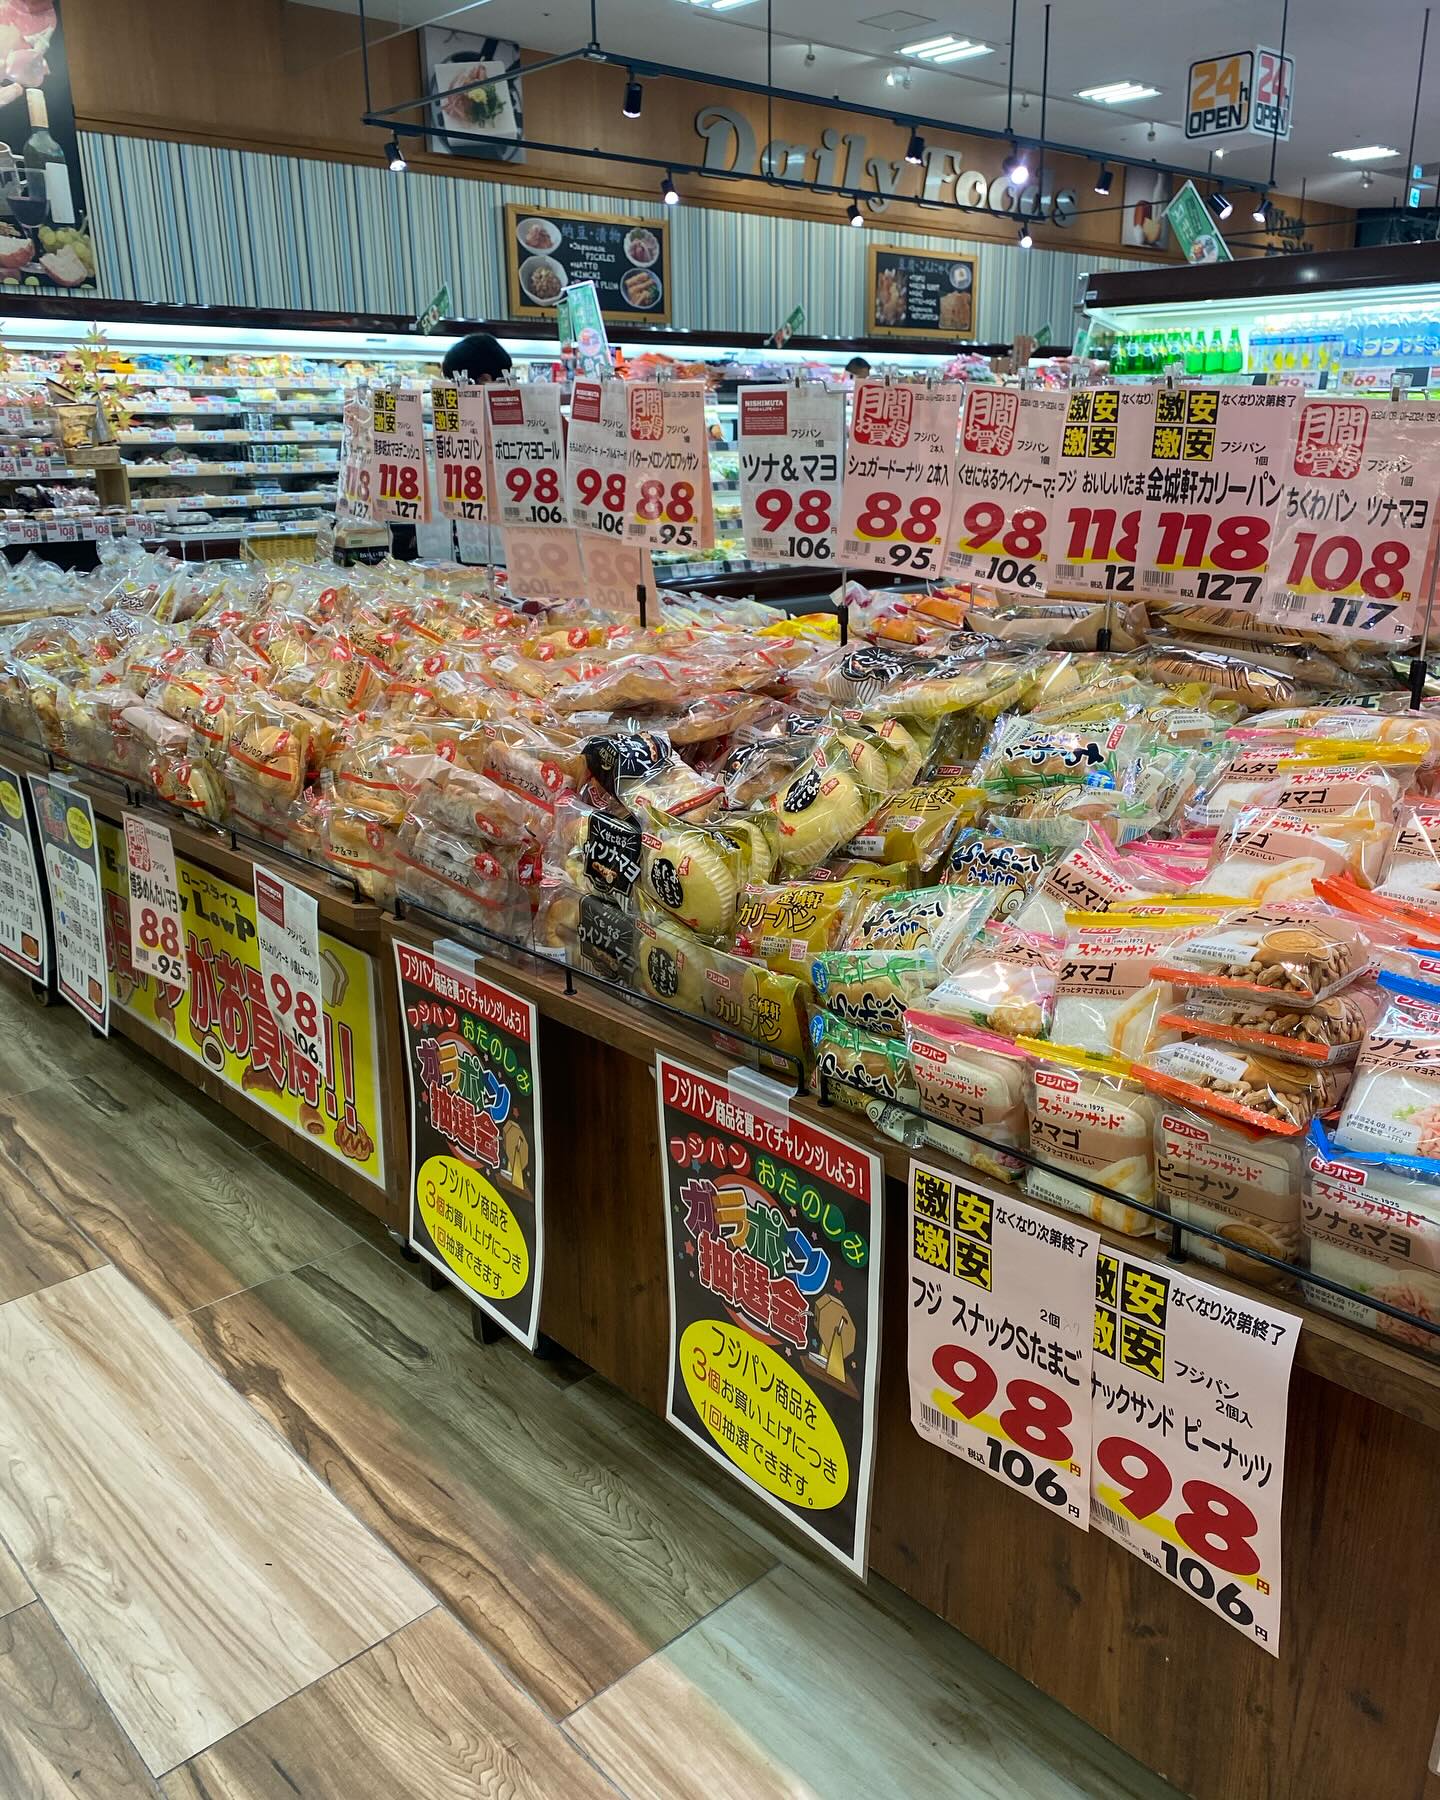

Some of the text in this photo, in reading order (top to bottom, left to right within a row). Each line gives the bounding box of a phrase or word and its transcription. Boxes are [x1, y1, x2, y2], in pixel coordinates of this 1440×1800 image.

[1190, 104, 1242, 134] OPEN
[1255, 102, 1287, 131] OPEN
[695, 106, 1079, 228] Daily Foods
[1121, 393, 1153, 405] なくなり
[1221, 393, 1297, 408] なくなり次第終了
[791, 429, 821, 438] フジパン
[914, 432, 940, 443] フジパン
[1017, 439, 1049, 453] フジパン
[1152, 426, 1216, 462] 激安
[1220, 441, 1266, 453] フジパン
[742, 453, 837, 482] ツナ&マヨ
[848, 456, 949, 487] シュガードーナツ 2本入
[1254, 456, 1268, 466] 1個
[1367, 459, 1413, 473] フジパン
[379, 463, 419, 500] 118
[444, 464, 483, 500] 118
[506, 467, 559, 503] 98
[576, 468, 626, 513] 98
[1058, 469, 1076, 492] フジ
[1146, 466, 1284, 508] 金城軒カリーパン
[395, 501, 418, 519] 127
[461, 502, 483, 520] 127
[531, 506, 562, 524] 106
[636, 479, 694, 523] 88
[755, 488, 832, 534] 98
[856, 492, 941, 543] 88
[1286, 488, 1428, 529] ちくわパン ツナマヨ
[660, 523, 693, 546] 95
[788, 537, 830, 559] 106
[963, 502, 1047, 559] 98
[1156, 511, 1271, 572] 118
[889, 543, 934, 570] 95
[986, 557, 1036, 588] 106
[1288, 532, 1411, 599] 108
[1197, 573, 1263, 604] 127
[1327, 597, 1397, 631] 117
[1291, 770, 1375, 785] スナックサンド
[1276, 787, 1330, 808] タマゴ
[642, 834, 663, 850] フジパン
[1069, 852, 1134, 896] スナックサンド
[139, 907, 180, 958] 88
[737, 902, 816, 933] カリーパン
[158, 954, 182, 981] 95
[1077, 943, 1162, 957] スナックサンド
[1060, 962, 1117, 983] タマゴ
[270, 973, 317, 1038] 98
[407, 1004, 457, 1028] フジパン
[292, 1027, 319, 1065] 106
[462, 1016, 530, 1093] おたのしみ
[913, 1043, 948, 1063] フジパン
[1369, 1035, 1440, 1060] ツナ&
[416, 1037, 511, 1124] ガラポン
[914, 1064, 988, 1100] スナックサンド
[1036, 1073, 1078, 1092] フジパン
[430, 1081, 500, 1169] 抽選会
[1037, 1096, 1125, 1131] スナックサンド
[1089, 1103, 1105, 1113] 1975
[668, 1072, 865, 1195] フジパン商品を買ってチャレンジしよう!
[1031, 1115, 1082, 1150] タマゴ
[1164, 1118, 1210, 1143] フジパン
[670, 1136, 748, 1170] フジパン
[1166, 1142, 1263, 1183] スナックサンド
[1223, 1153, 1241, 1164] 1975
[438, 1160, 508, 1233] フジパン商品を
[1157, 1158, 1240, 1201] ピーナツ
[757, 1158, 866, 1265] おたのしみ
[1314, 1181, 1425, 1228] スナックサンド
[1380, 1197, 1400, 1208] 1975
[425, 1179, 522, 1276] 3個お買い上げにつき
[680, 1178, 831, 1295] ガラポン
[996, 1206, 1089, 1258] なくなり次第終了
[1302, 1201, 1411, 1258] ツナ&マヨ
[431, 1223, 505, 1297] 1回抽選できます。
[913, 1214, 992, 1293] 激安
[697, 1230, 810, 1350] 抽選会
[912, 1276, 1083, 1387] フジ スナックSたまご
[1171, 1287, 1287, 1347] なくなり次第終了
[711, 1325, 818, 1431] フジパン商品を
[1173, 1359, 1242, 1400] フジパン
[692, 1346, 838, 1485] 3個お買い上げにつき
[932, 1343, 1074, 1463] 98
[1215, 1401, 1254, 1430] 2個入
[700, 1399, 814, 1507] 1回抽選できます。
[967, 1447, 986, 1466] 税込
[986, 1435, 1068, 1507] 106
[1184, 1420, 1273, 1489] ピーナッツ
[1096, 1434, 1261, 1577] 98
[1142, 1539, 1254, 1627] 税込 106
